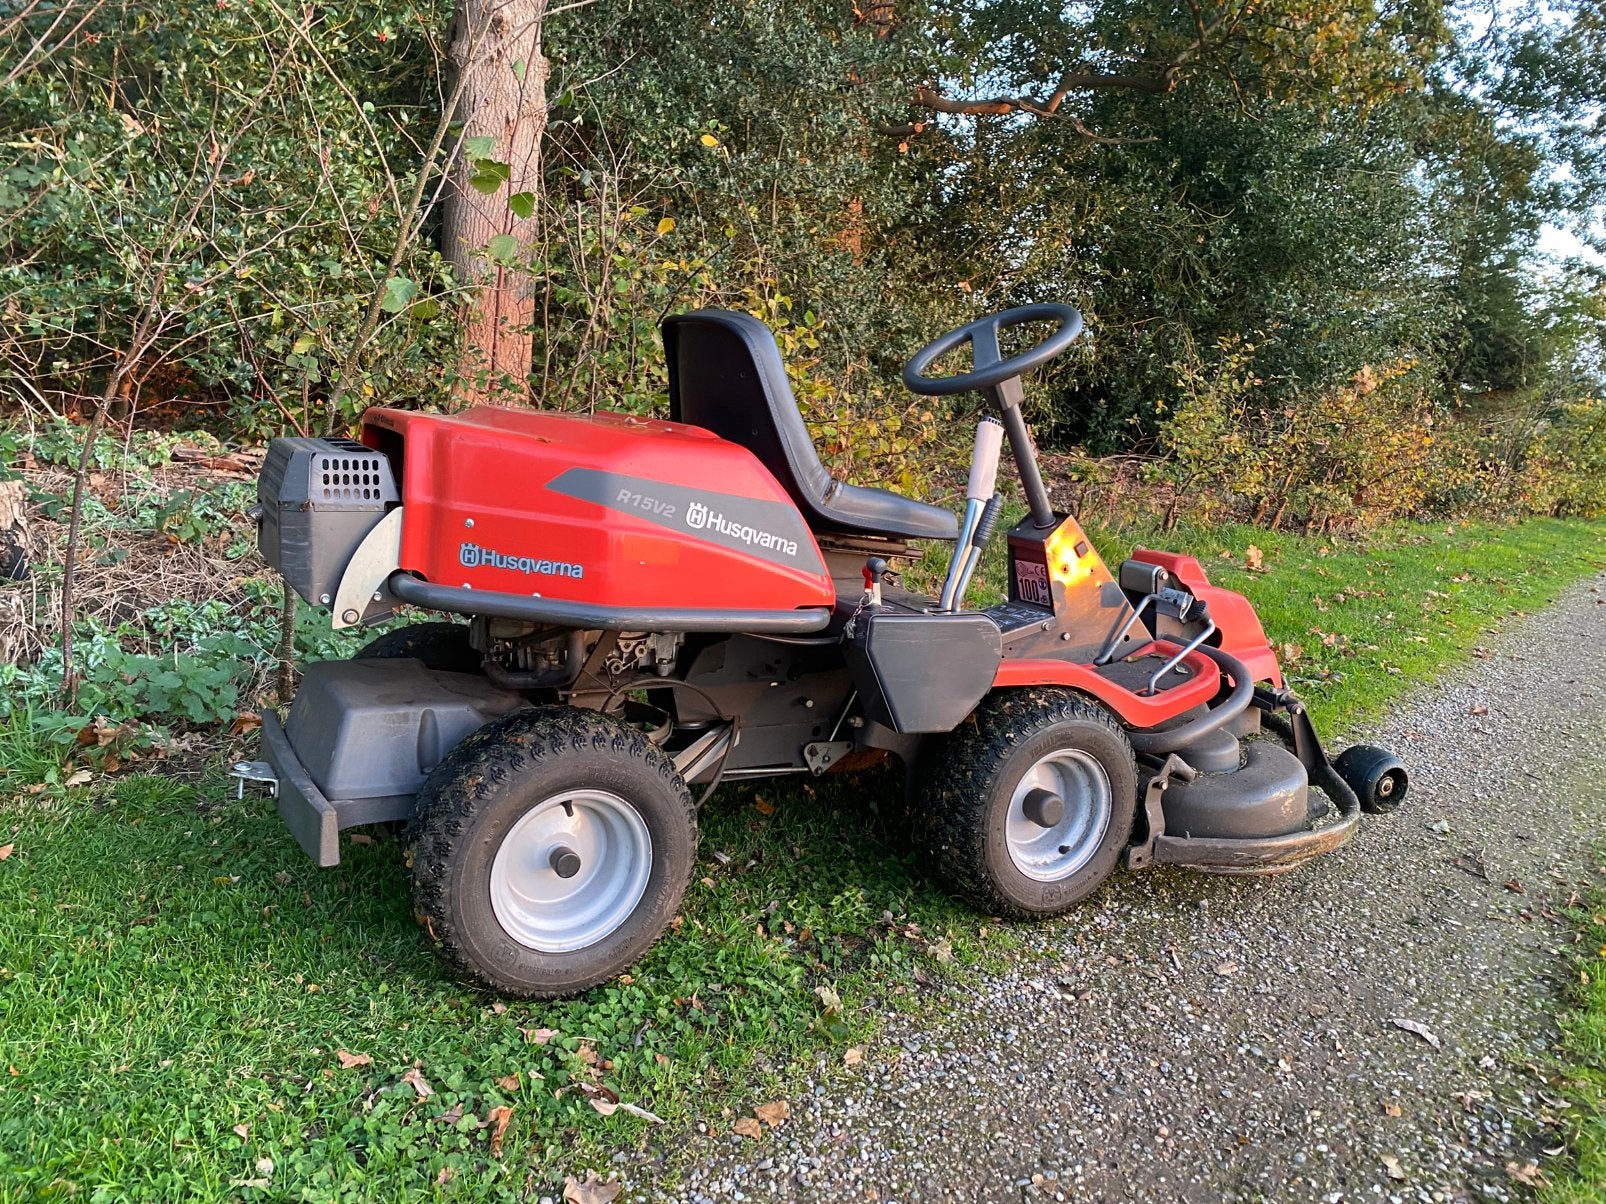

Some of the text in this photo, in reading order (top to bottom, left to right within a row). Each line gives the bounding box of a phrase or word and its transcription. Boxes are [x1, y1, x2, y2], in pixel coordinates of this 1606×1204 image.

[616, 489, 677, 518] R15V2
[706, 510, 798, 556] Husqvarna
[481, 548, 584, 579] Husqvarna
[1019, 578, 1040, 602] 100
